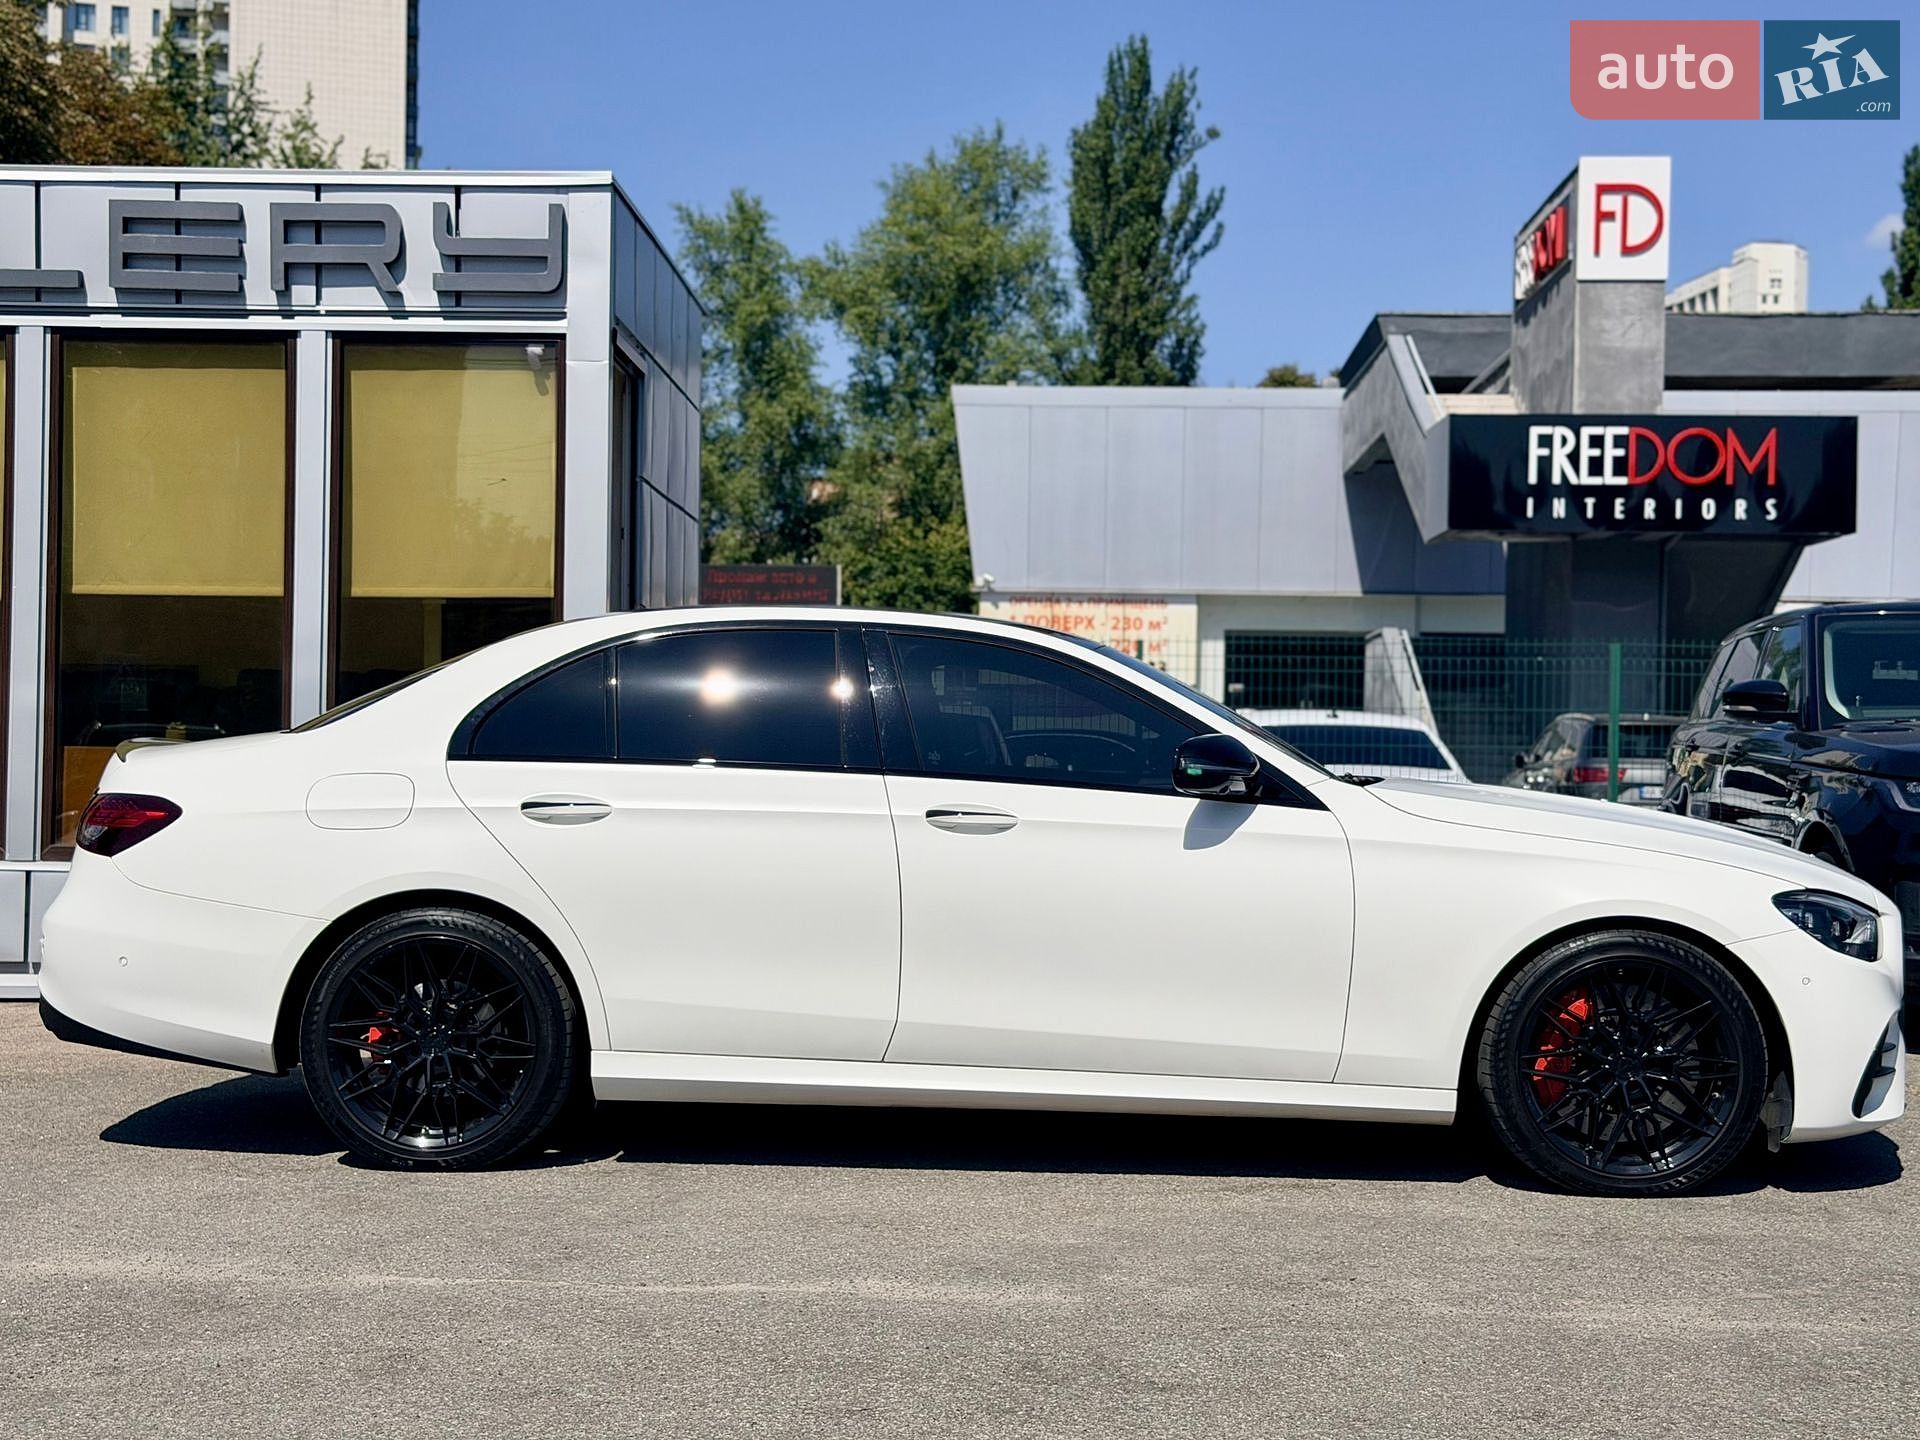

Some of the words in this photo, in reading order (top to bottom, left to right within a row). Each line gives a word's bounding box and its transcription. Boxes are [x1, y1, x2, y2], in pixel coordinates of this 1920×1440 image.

[1594, 183, 1664, 258] FD
[1527, 425, 1777, 486] FREEDOM
[1526, 496, 1778, 520] INTERIORS
[1024, 616, 1094, 632] ПОВЕРХ
[1112, 616, 1143, 630] 230
